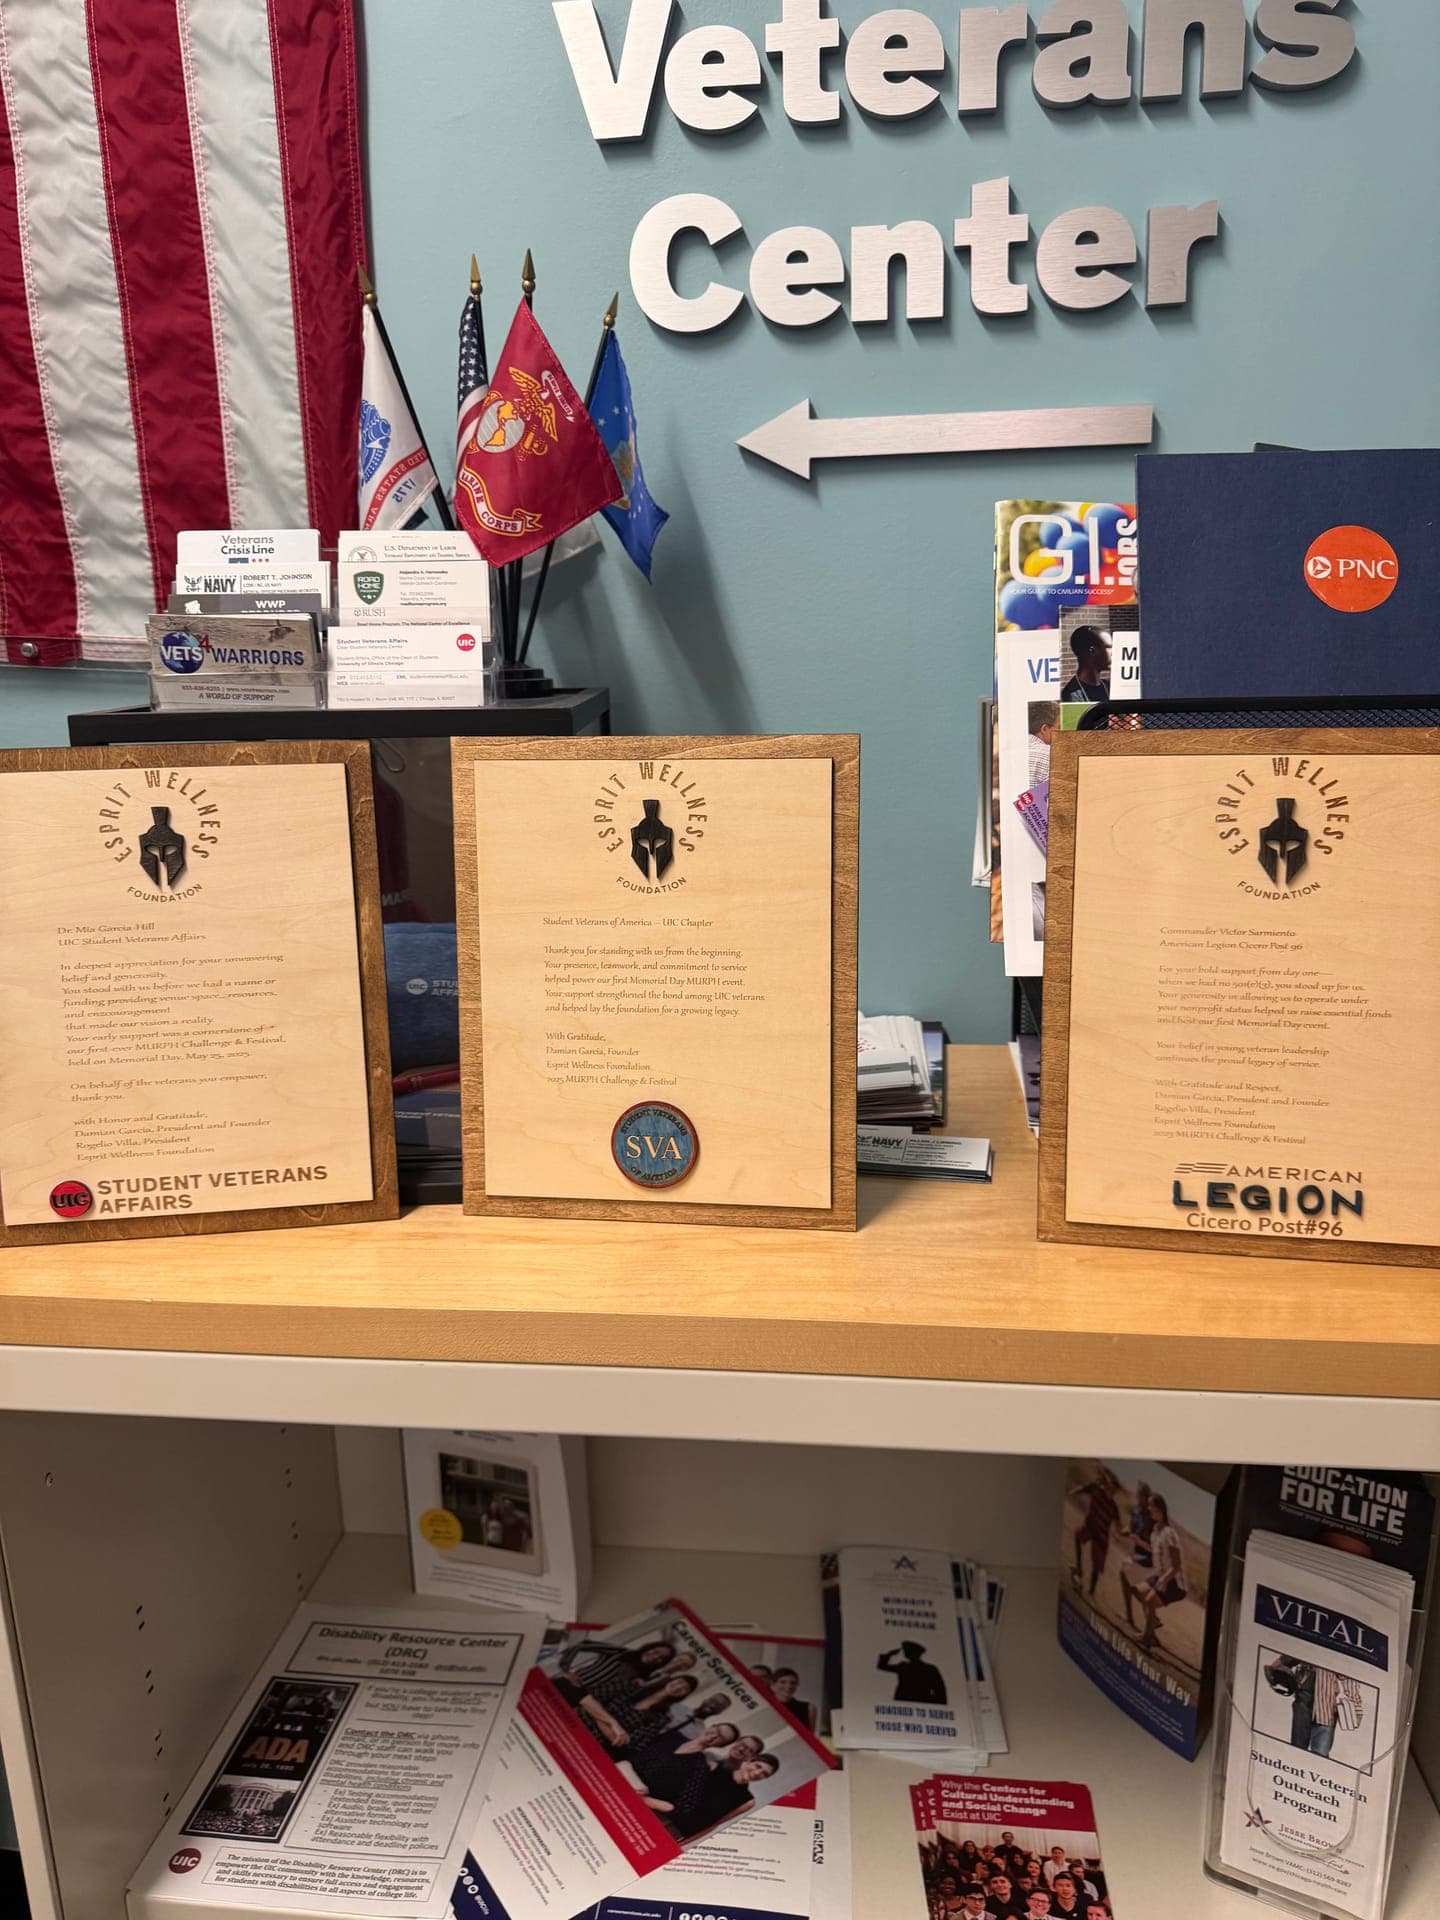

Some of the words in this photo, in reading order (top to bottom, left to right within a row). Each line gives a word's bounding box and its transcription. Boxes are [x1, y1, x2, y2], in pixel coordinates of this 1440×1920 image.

[552, 0, 1358, 141] Veterans
[629, 177, 1219, 333] Center
[481, 510, 518, 531] CORPS
[221, 535, 274, 544] Veterans
[221, 545, 251, 555] Crisis
[252, 545, 275, 555] Line
[243, 574, 268, 582] ROBERT
[1338, 558, 1396, 580] PNC
[204, 578, 236, 592] NAVY
[255, 600, 287, 609] WWP
[362, 608, 386, 617] RUSH
[160, 646, 204, 661] VETS
[199, 634, 212, 653] 4
[211, 648, 305, 667] WARRIORS
[458, 638, 475, 647] UIC
[594, 773, 626, 852] ESPRIT
[639, 762, 708, 852] WELLNESS
[1215, 769, 1254, 855] ESPRIT
[1272, 757, 1350, 855] WELLNESS
[99, 783, 132, 863] ESPRIT
[144, 770, 220, 859] WELLNESS
[128, 883, 203, 902] FOUNDATION
[616, 876, 687, 894] FOUNDATION
[1237, 880, 1321, 900] FOUNDATION
[543, 917, 574, 926] Student
[575, 917, 608, 926] Veterans
[609, 916, 618, 929] of
[619, 918, 652, 926] America
[662, 918, 679, 927] UIC
[680, 918, 714, 929] Chapter
[82, 936, 122, 945] Student
[125, 934, 170, 944] Veterans
[170, 931, 207, 943] Affairs
[544, 945, 570, 955] Thank
[570, 948, 585, 958] you
[585, 945, 597, 957] for
[599, 946, 634, 958] standing
[635, 946, 652, 955] with
[654, 948, 664, 956] us
[663, 946, 685, 958] from
[686, 947, 699, 956] the
[544, 974, 570, 985] helped
[571, 977, 595, 986] power
[612, 975, 628, 986] first
[630, 976, 667, 985] Memorial
[669, 977, 685, 987] Day
[686, 977, 721, 986] MURPH
[544, 1003, 560, 1011] and
[562, 1003, 588, 1013] helped
[589, 1003, 600, 1014] lay
[602, 1004, 616, 1012] the
[616, 1003, 660, 1015] foundation
[660, 1004, 673, 1015] for
[680, 1006, 713, 1017] growing
[546, 1032, 565, 1041] With
[546, 1061, 569, 1071] Esprit
[571, 1061, 605, 1069] Wellness
[606, 1061, 650, 1071] Foundation
[564, 1075, 599, 1084] MURPH
[600, 1076, 638, 1087] Challenge
[649, 1077, 677, 1086] Festival
[625, 1134, 682, 1160] SVA
[98, 1174, 203, 1196] STUDENT
[209, 1165, 329, 1189] VETERANS
[1227, 1164, 1363, 1184] AMERICAN
[100, 1194, 193, 1214] AFFAIRS
[1172, 1180, 1364, 1217] LEGION
[1187, 1212, 1252, 1231] Cicero
[1259, 1216, 1343, 1236] Post#96
[1283, 1465, 1408, 1510] EDUCATION
[1280, 1476, 1335, 1515] FOR
[1341, 1495, 1406, 1536] LIFE
[1271, 1594, 1374, 1653] VITAL
[319, 1626, 386, 1643] Disability
[389, 1631, 456, 1647] Resource
[459, 1637, 508, 1648] Center
[385, 1646, 428, 1660] (DRC)
[672, 1620, 711, 1659] Career
[706, 1657, 760, 1710] Services
[1166, 1675, 1190, 1707] Way
[241, 1735, 309, 1763] ADA
[1250, 1749, 1306, 1779] Student
[1309, 1771, 1367, 1803] Veteran
[940, 1780, 961, 1791] Why
[963, 1782, 980, 1791] the
[982, 1783, 1028, 1794] Centers
[1029, 1786, 1046, 1796] for
[1273, 1774, 1340, 1808] Outreach
[941, 1789, 988, 1801] Cultural
[988, 1793, 1075, 1809] Understanding
[942, 1801, 964, 1809] and
[965, 1801, 1002, 1812] Social
[1003, 1804, 1047, 1817] Change
[1272, 1790, 1337, 1823] Program
[942, 1808, 969, 1820] Exist
[969, 1811, 981, 1821] at
[982, 1811, 1002, 1822] UIC
[171, 1854, 199, 1868] UIC
